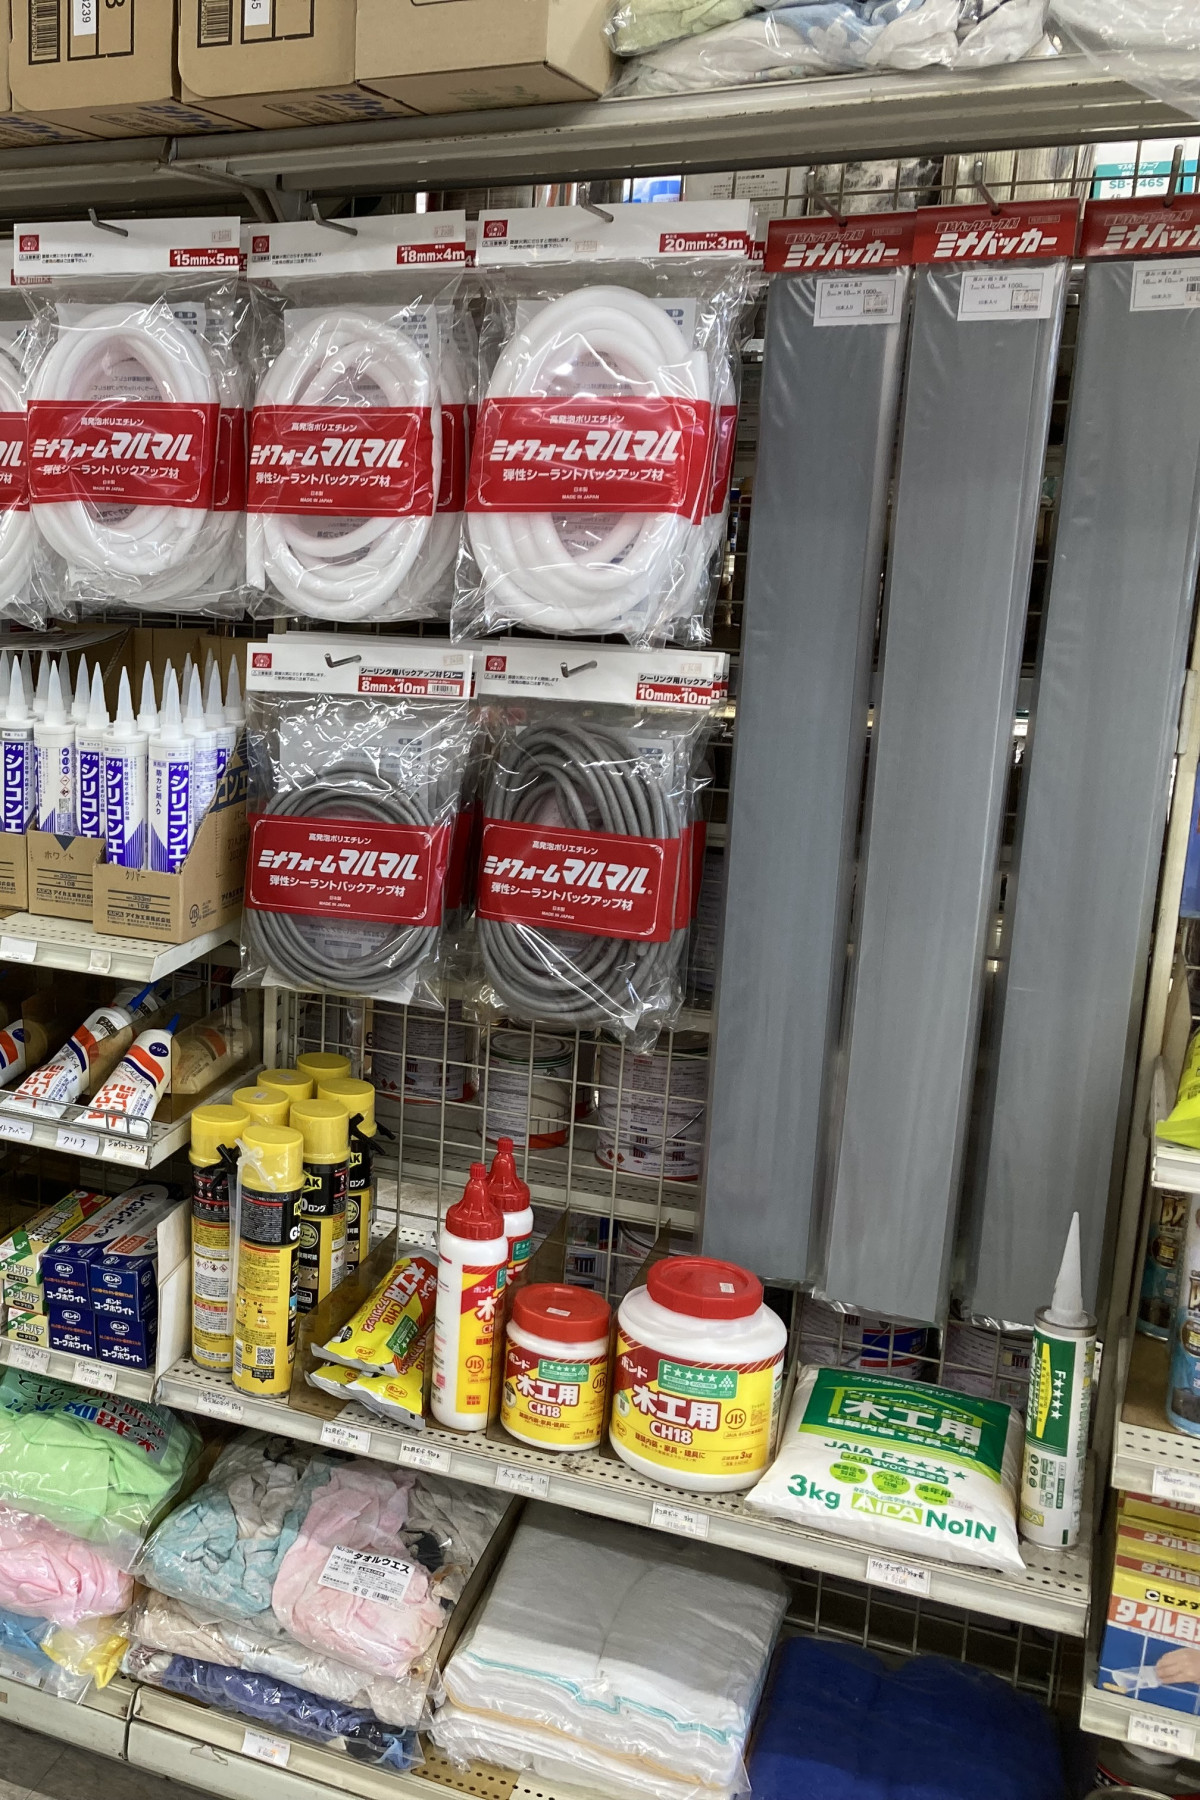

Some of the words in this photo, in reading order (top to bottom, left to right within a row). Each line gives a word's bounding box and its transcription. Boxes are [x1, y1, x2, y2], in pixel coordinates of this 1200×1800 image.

[1109, 178, 1164, 189] SB-46S
[665, 236, 744, 252] 20mm×3m
[934, 229, 1058, 259] ミナバッカー
[173, 252, 239, 267] 15mm×5m
[400, 247, 465, 264] 18mm×4m
[783, 239, 900, 268] ミナバッカー
[80, 416, 144, 427] 高発泡ポリエチレン
[549, 413, 626, 424] 高発泡ポリエチレン
[291, 422, 358, 433] 高発泡ポリエチレン
[32, 432, 194, 463] ミナフォームマルマル
[249, 438, 405, 469] ミナフォームマルマル
[490, 430, 684, 462] ミナフォームマルマル
[42, 462, 180, 481] 弾性シーラントバックアップ材
[255, 471, 392, 488] 弾性シーラントバックアップ材
[502, 466, 665, 483] 弾性シーラントバックアップ材
[360, 666, 443, 678] シーリング用バックアップ材
[361, 679, 426, 695] 8mm×10m
[637, 688, 712, 706] 10mm×10m
[81, 753, 99, 761] アイカ
[170, 764, 188, 772] アイカ
[308, 832, 373, 846] 高発泡ポリエチレン
[532, 839, 600, 856] 高発泡ポリエチレン
[258, 848, 420, 881] ミナフォームマルマル
[483, 855, 649, 896] ミナフォームマルマル
[268, 873, 406, 898] 弾性シーラントバックアップ材
[490, 881, 635, 913] 弾性シーラントバックアップ材
[1, 1260, 35, 1278] ウッドパテ
[47, 1290, 87, 1305] コークホワイト
[473, 1286, 494, 1294] ボンド
[94, 1301, 135, 1316] コークホワイト
[11, 1320, 44, 1336] ウッドパテ
[53, 1337, 93, 1352] コークホワイト
[102, 1348, 143, 1363] コークホワイト
[508, 1352, 530, 1369] ボンド
[621, 1356, 648, 1380] ボンド
[516, 1373, 579, 1407] 木工用
[528, 1400, 562, 1419] CH18
[632, 1382, 721, 1431] 木工用
[726, 1411, 745, 1428] JIS
[843, 1399, 982, 1447] 木工用
[649, 1421, 693, 1445] CH18
[824, 1440, 875, 1456] JAIA
[787, 1474, 842, 1510] 3kg
[852, 1493, 922, 1525] AICA
[926, 1509, 997, 1543] No1N
[352, 1552, 410, 1574] タオルウエス
